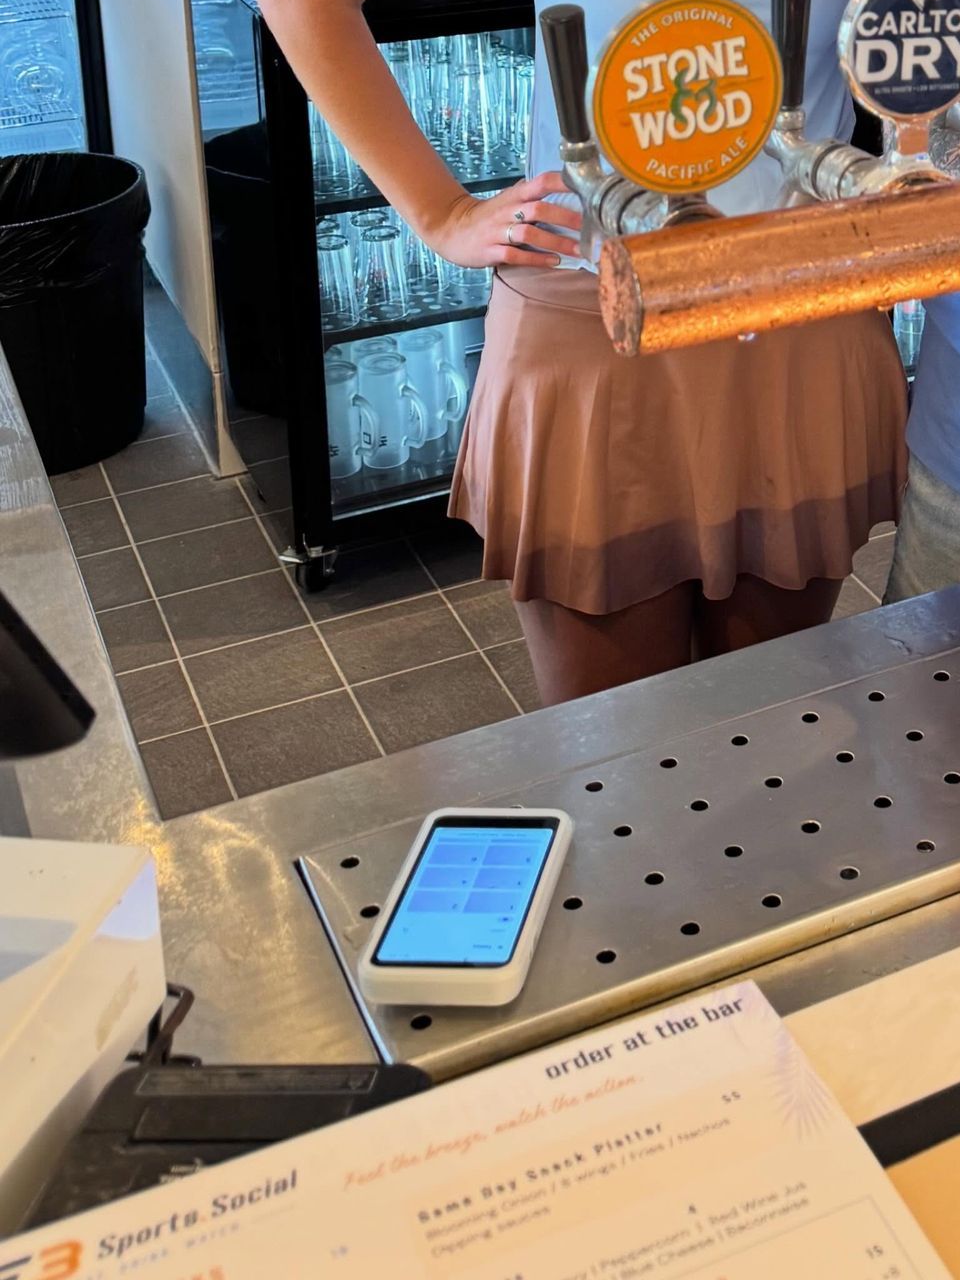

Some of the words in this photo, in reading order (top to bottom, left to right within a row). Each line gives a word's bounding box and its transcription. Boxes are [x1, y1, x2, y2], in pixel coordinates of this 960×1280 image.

[630, 21, 659, 48] THE
[661, 7, 734, 30] ORIGINAL
[622, 35, 749, 104] STONE
[670, 67, 717, 124] &
[629, 89, 753, 151] WOOD
[646, 157, 715, 181] PACIFIC
[720, 135, 749, 167] ALE
[544, 1043, 614, 1080] order
[622, 1029, 652, 1052] at
[654, 1013, 700, 1039] the
[701, 996, 744, 1022] bar
[389, 1152, 421, 1172] the
[493, 1103, 547, 1134] watch
[550, 1093, 580, 1114] the
[584, 1074, 644, 1104] action.
[481, 1178, 517, 1200] Day
[525, 1151, 588, 1182] Snack
[593, 1122, 663, 1157] Platter
